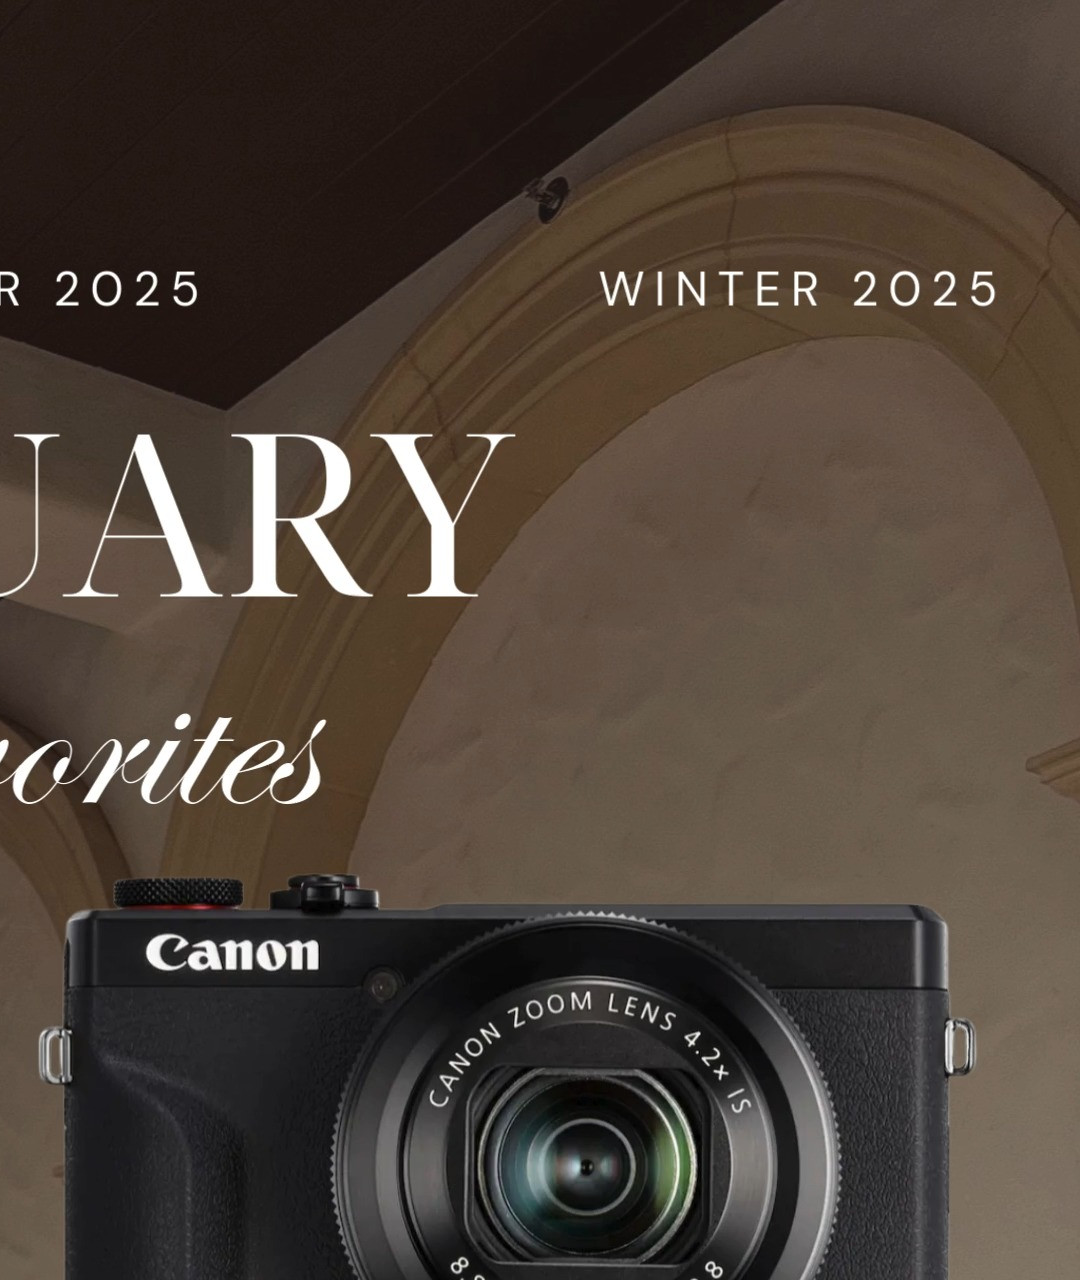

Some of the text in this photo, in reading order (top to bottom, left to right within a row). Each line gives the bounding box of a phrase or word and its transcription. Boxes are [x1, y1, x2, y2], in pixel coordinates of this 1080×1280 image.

[146, 933, 320, 971] Canon
[429, 1022, 502, 1108] CANON
[507, 991, 592, 1029] ZOOM
[608, 993, 677, 1031] LENS
[727, 1088, 752, 1114] IS
